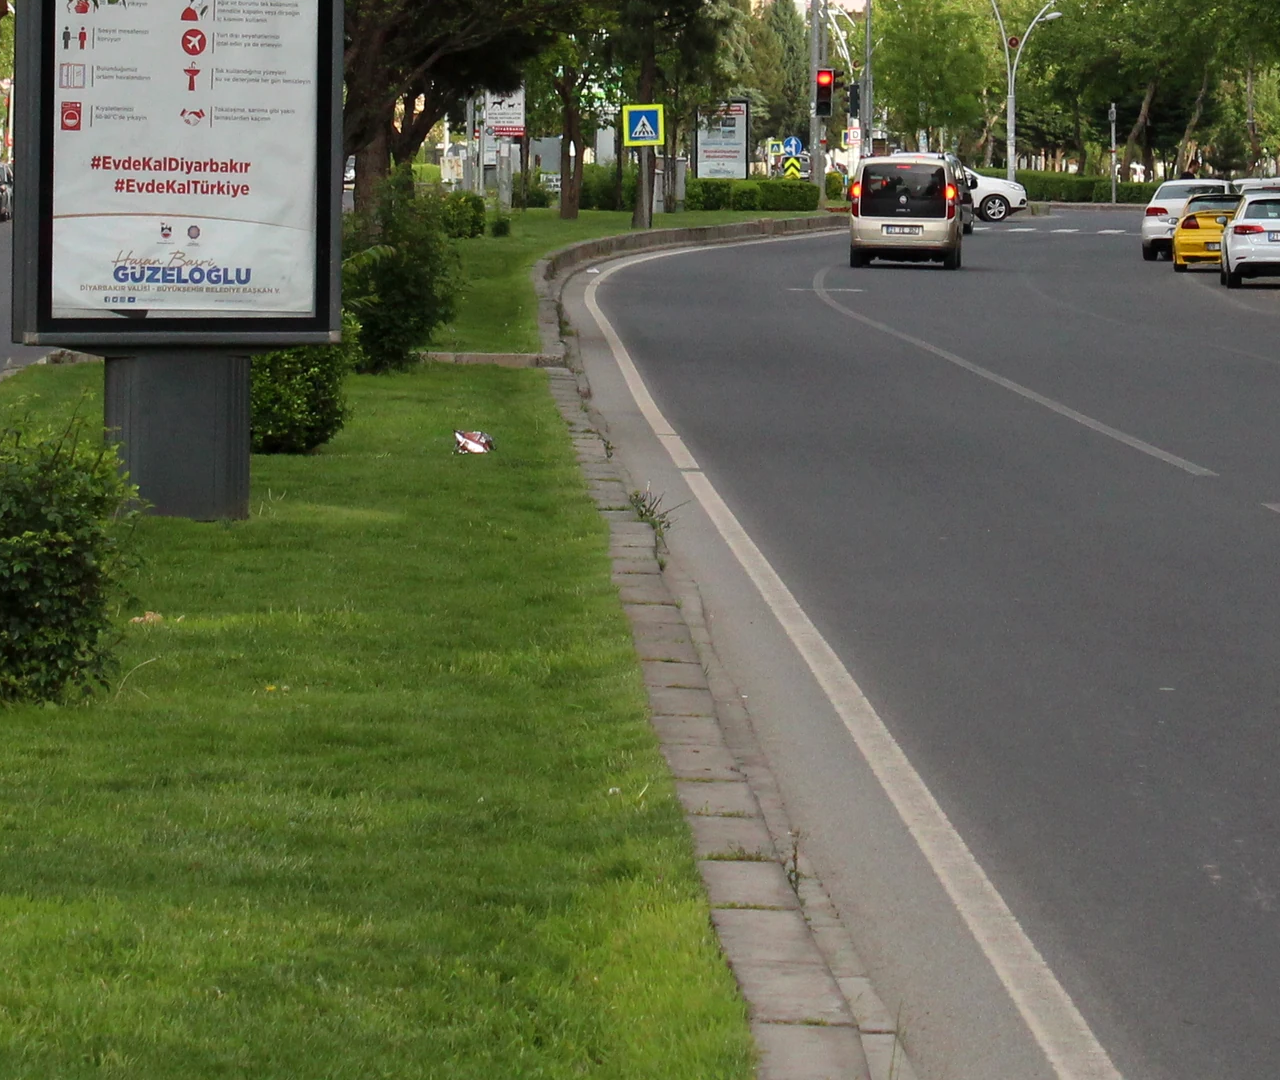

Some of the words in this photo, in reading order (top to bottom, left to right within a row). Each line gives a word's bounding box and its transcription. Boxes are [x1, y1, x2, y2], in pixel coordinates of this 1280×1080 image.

[91, 155, 251, 175] #EvdeKalDiyarbakır
[114, 178, 250, 198] #EvdeKalTürkiye
[111, 250, 163, 267] Hasan
[113, 265, 252, 285] GÜZELOĞLU
